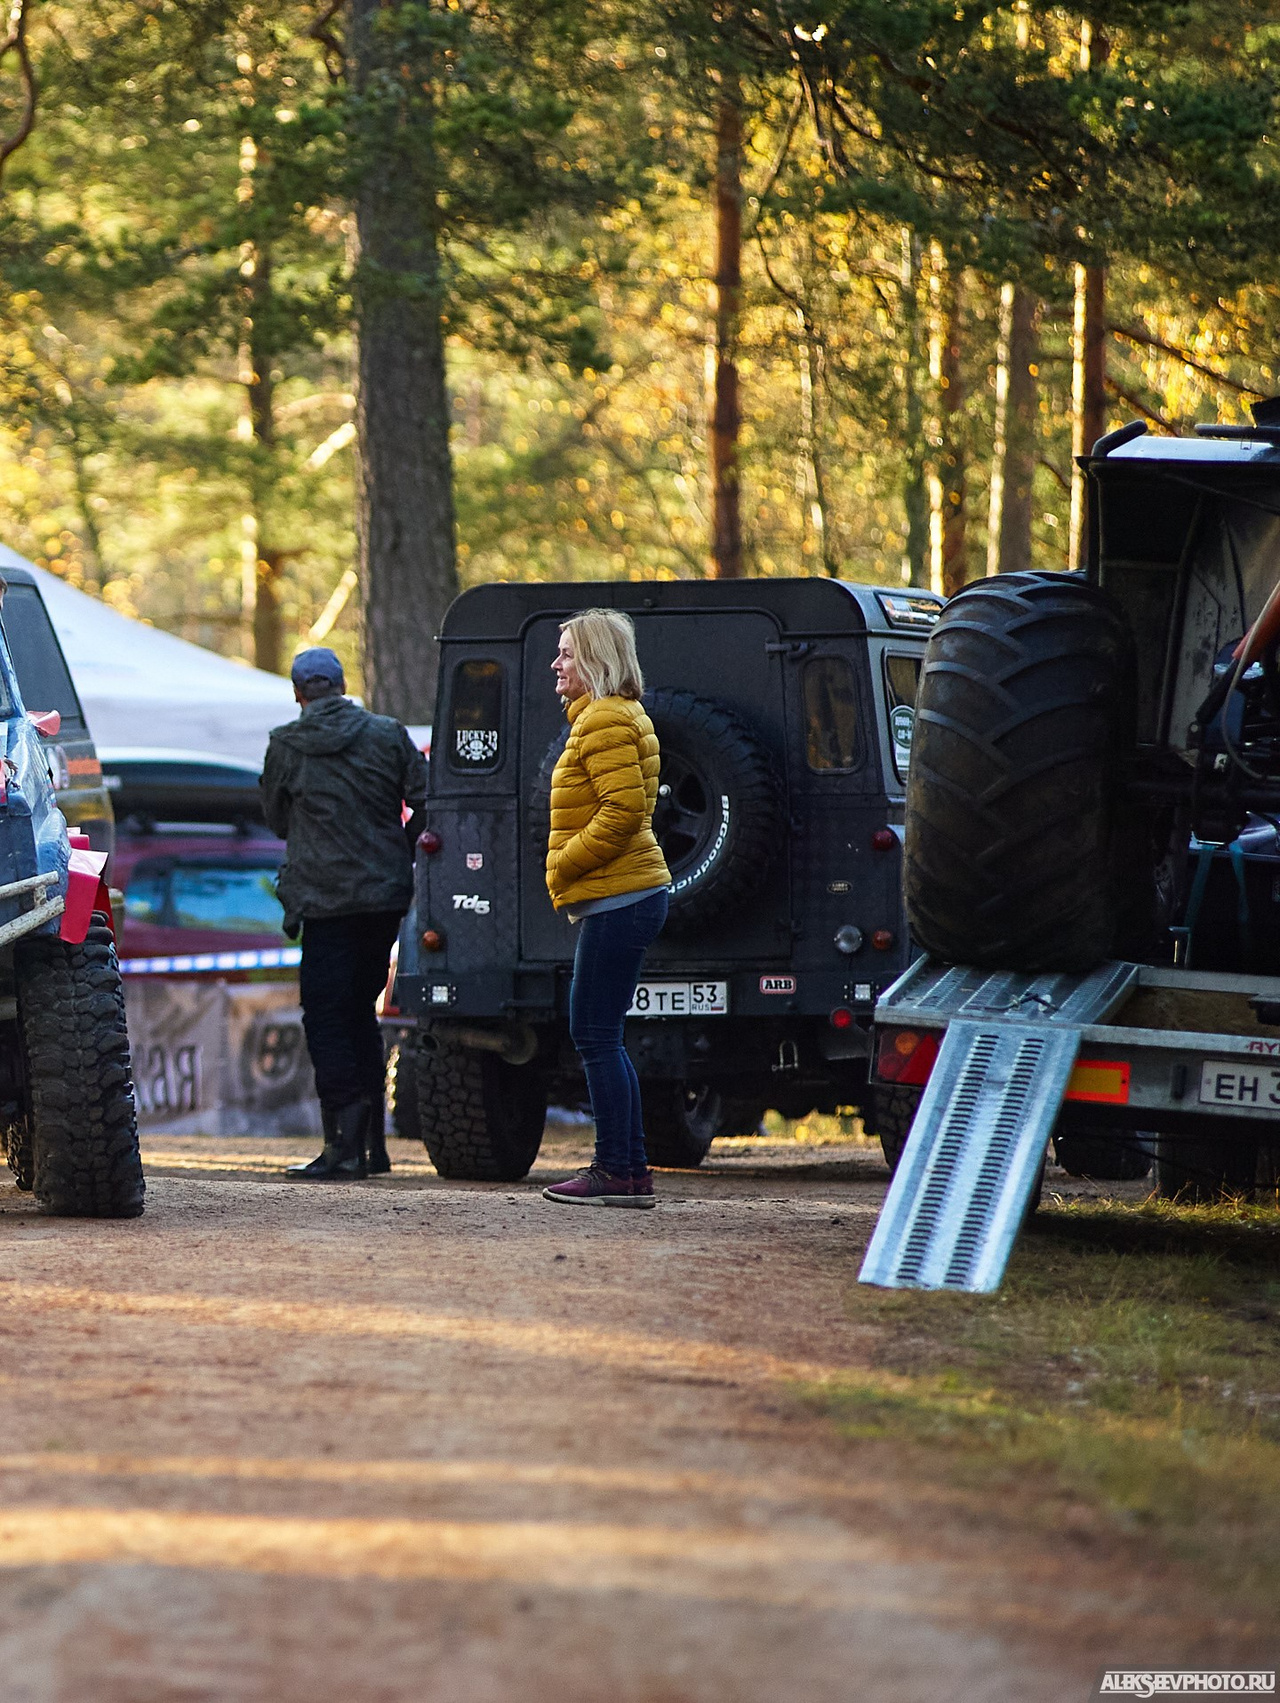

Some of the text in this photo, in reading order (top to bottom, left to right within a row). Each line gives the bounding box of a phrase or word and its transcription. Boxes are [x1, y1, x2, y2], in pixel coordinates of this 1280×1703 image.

[452, 894, 491, 914] Td5
[764, 979, 793, 990] ARB
[629, 984, 718, 1011] 8TE 53
[691, 1003, 710, 1011] RUS
[1248, 1041, 1280, 1053] RY
